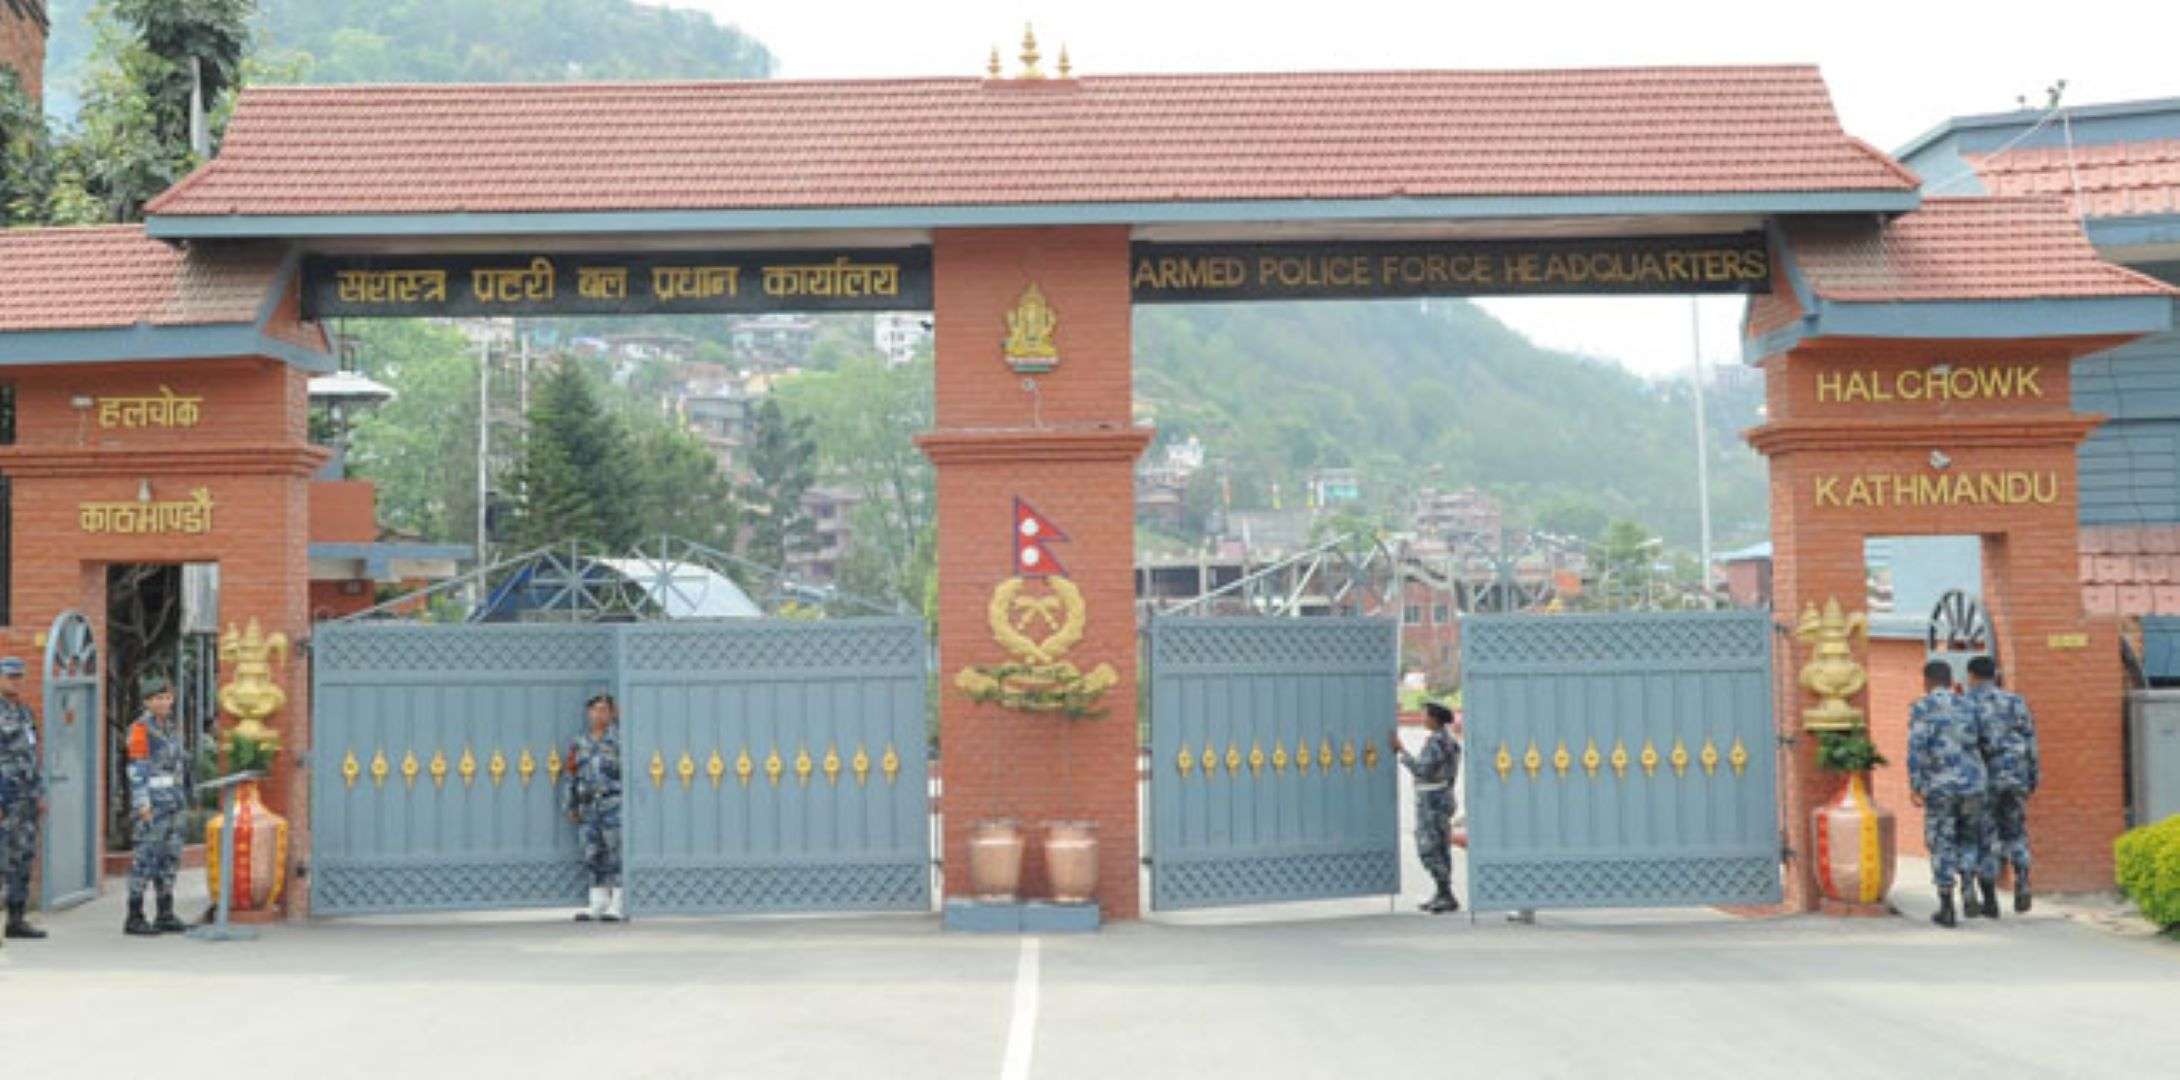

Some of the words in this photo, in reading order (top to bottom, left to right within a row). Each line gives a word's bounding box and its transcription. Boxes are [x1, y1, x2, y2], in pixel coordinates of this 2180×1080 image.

[577, 266, 628, 299] बल
[652, 265, 740, 300] प्रधान
[761, 255, 899, 297] कार्यालय
[1135, 256, 1246, 288] ARMED
[1258, 256, 1372, 286] POLICE
[1382, 253, 1492, 284] FORCE
[1504, 249, 1767, 283] HEADQUARTERS
[1816, 365, 2043, 402] HALCHOWK
[98, 384, 204, 428] हलचोक
[1813, 470, 2058, 507] KATHMANDU
